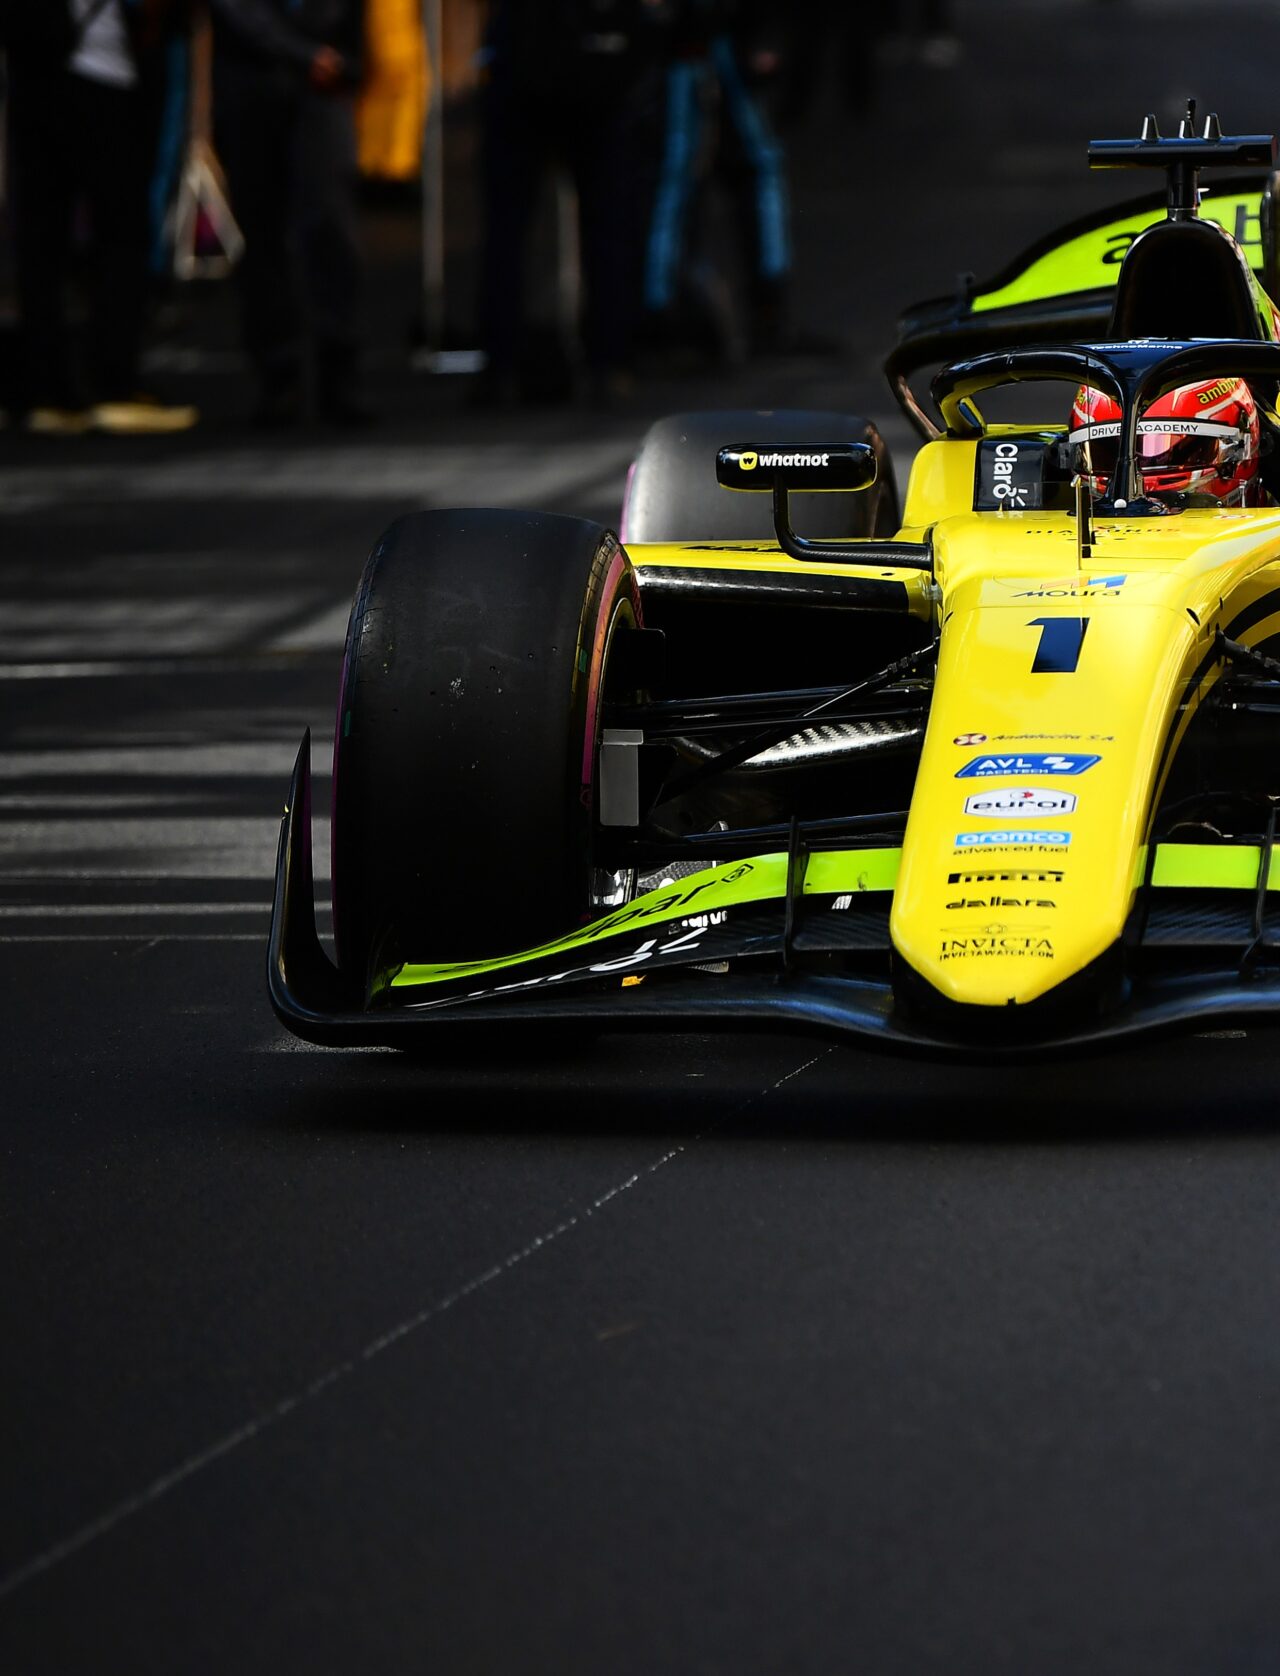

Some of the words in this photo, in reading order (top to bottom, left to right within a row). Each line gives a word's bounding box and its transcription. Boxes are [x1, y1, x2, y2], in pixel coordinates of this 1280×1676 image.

[1091, 426, 1121, 437] DRIVE
[1136, 424, 1199, 434] ACADEMY
[759, 453, 829, 467] whatnot
[992, 443, 1019, 500] Claro
[1025, 616, 1091, 674] 1
[978, 758, 1032, 770] AVL
[973, 799, 1068, 810] eurol
[960, 831, 1066, 844] aramco
[953, 845, 1034, 856] advanced
[1039, 845, 1069, 854] fuel
[947, 869, 1065, 884] PIRELLI
[946, 895, 1057, 909] dallara
[941, 936, 1053, 952] INVICTA
